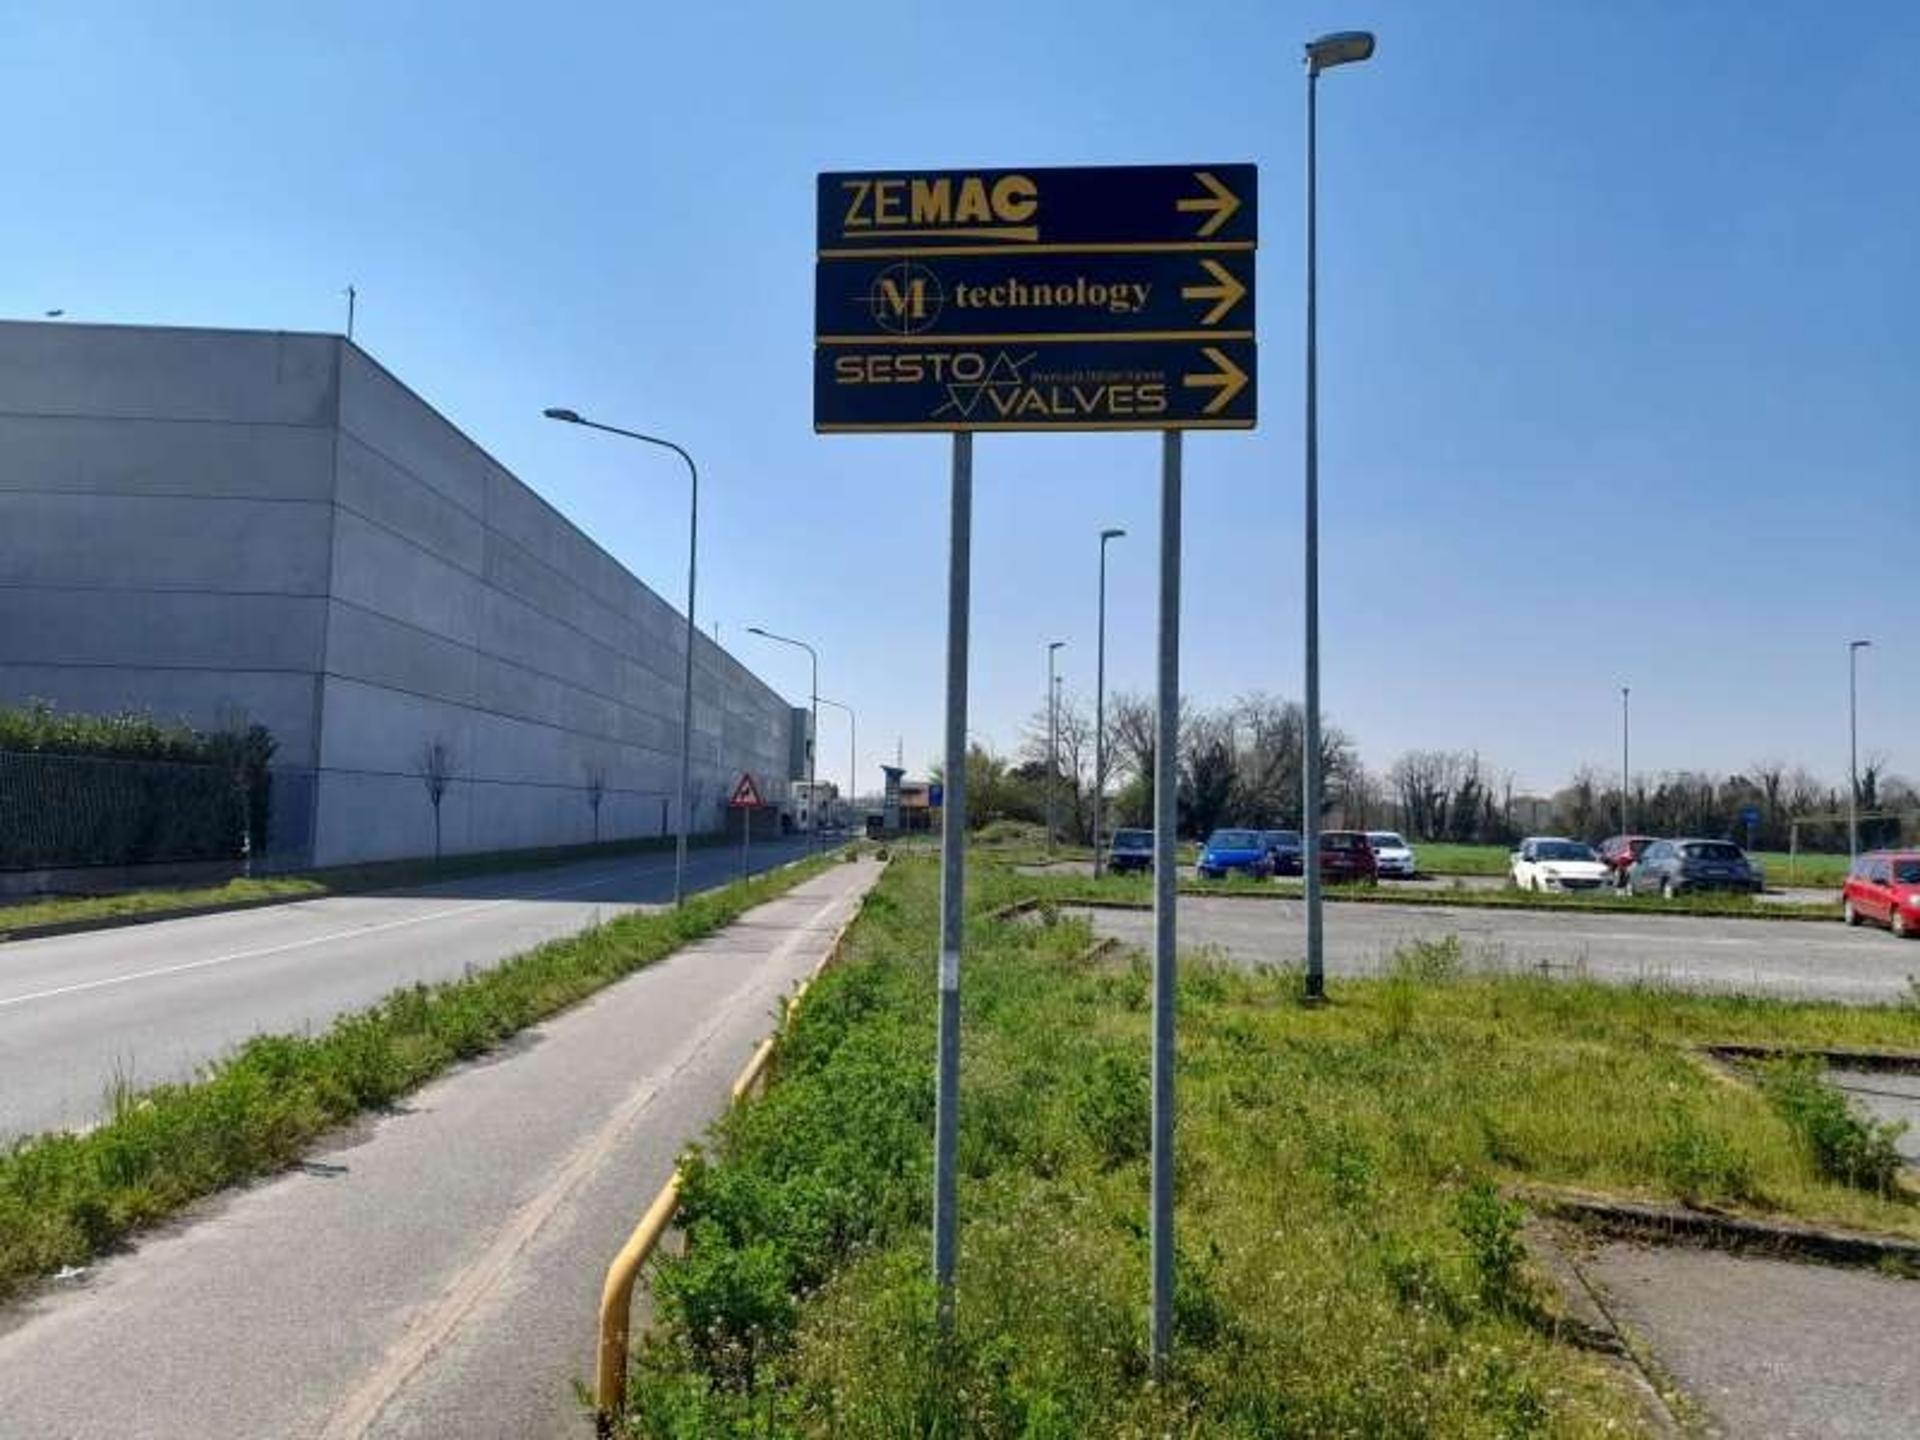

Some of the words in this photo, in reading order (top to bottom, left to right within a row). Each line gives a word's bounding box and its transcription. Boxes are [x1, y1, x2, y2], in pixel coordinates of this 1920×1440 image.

[842, 175, 1038, 226] ZEMAC
[879, 278, 928, 319] M
[956, 277, 1152, 312] technology
[834, 353, 984, 384] SESTO
[988, 384, 1168, 415] VALVES
